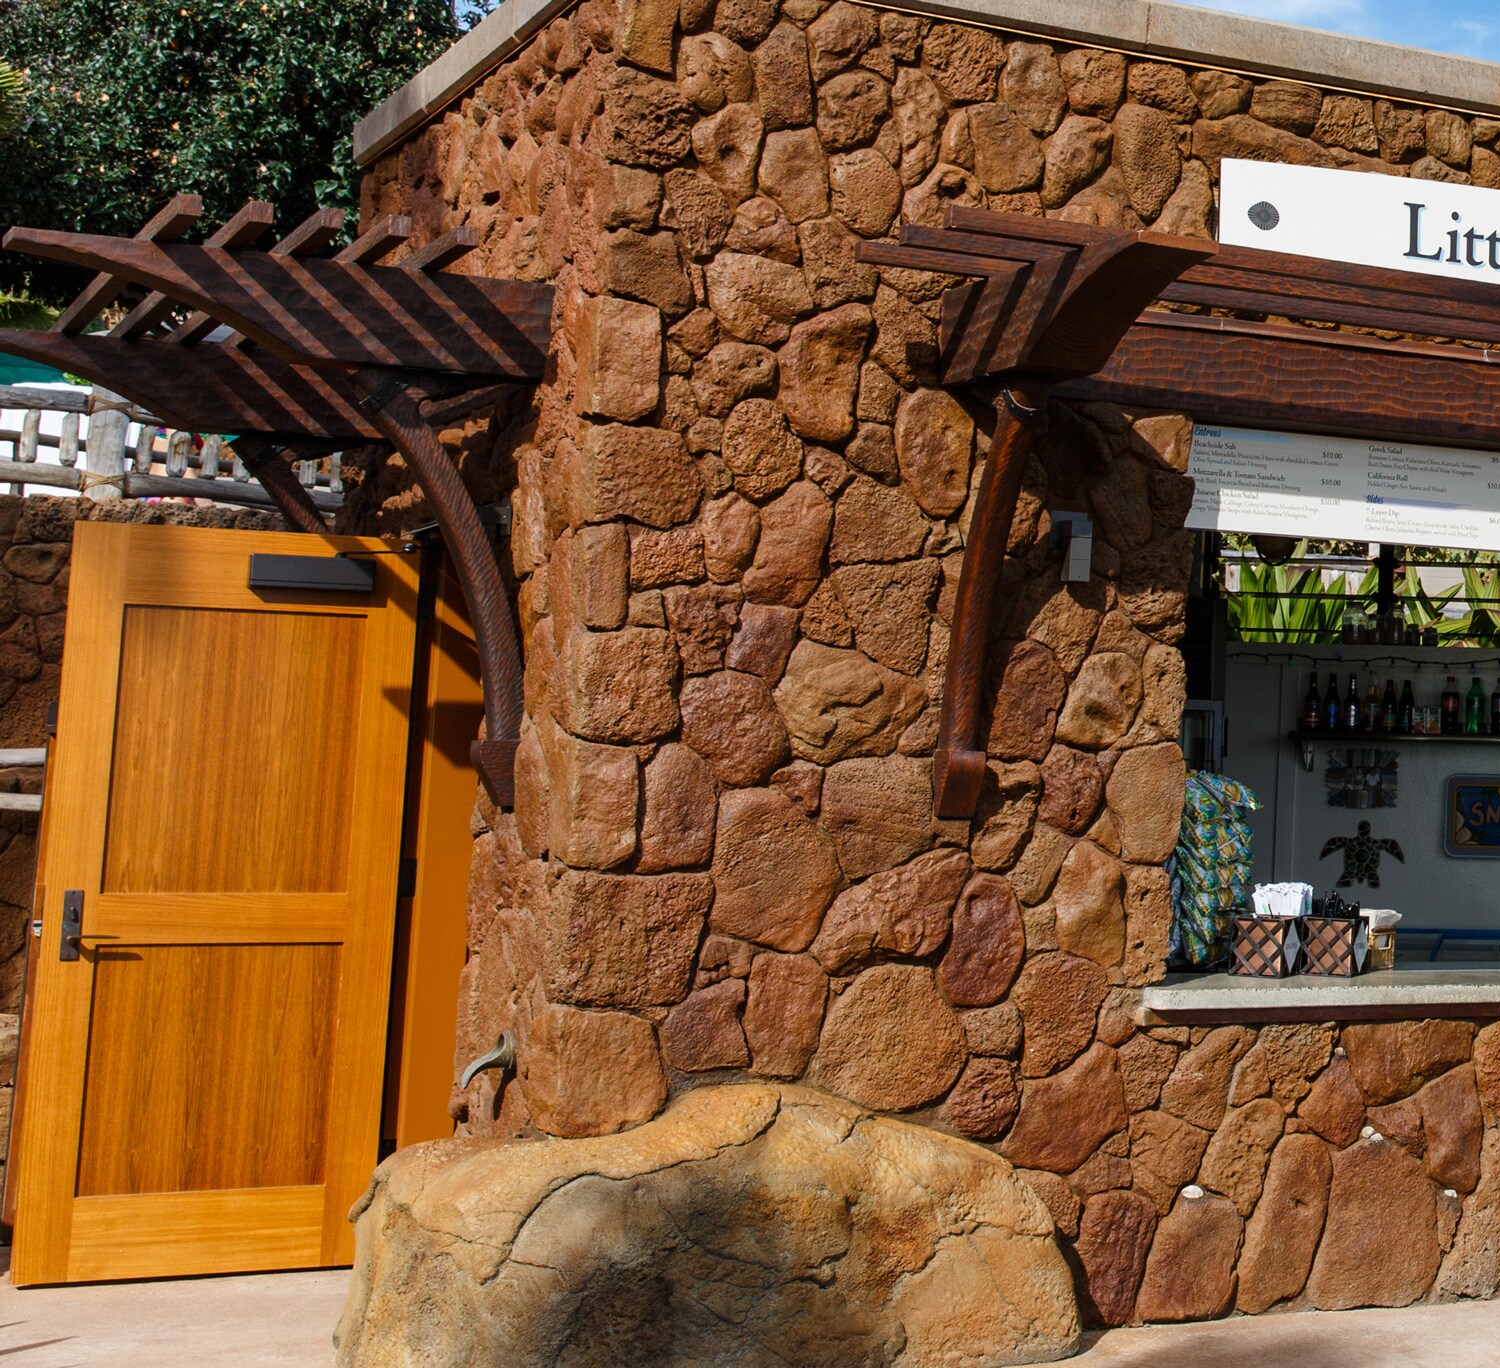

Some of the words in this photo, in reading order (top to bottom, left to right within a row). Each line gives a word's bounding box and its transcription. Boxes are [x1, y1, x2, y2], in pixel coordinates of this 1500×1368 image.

[1194, 426, 1221, 437] Entrees
[1194, 440, 1223, 449] Beachside
[1224, 442, 1237, 450] Sub
[1368, 445, 1386, 453] Greek
[1193, 468, 1226, 477] Mozzarella
[1233, 471, 1257, 479] Tomato
[1257, 473, 1286, 482] Sandwich
[1367, 472, 1396, 480] California
[1321, 479, 1341, 487] $10.00
[1216, 490, 1242, 498] Chicken
[1320, 498, 1341, 506] $10.00
[1366, 494, 1384, 504] Sides
[1388, 509, 1400, 518] Dip
